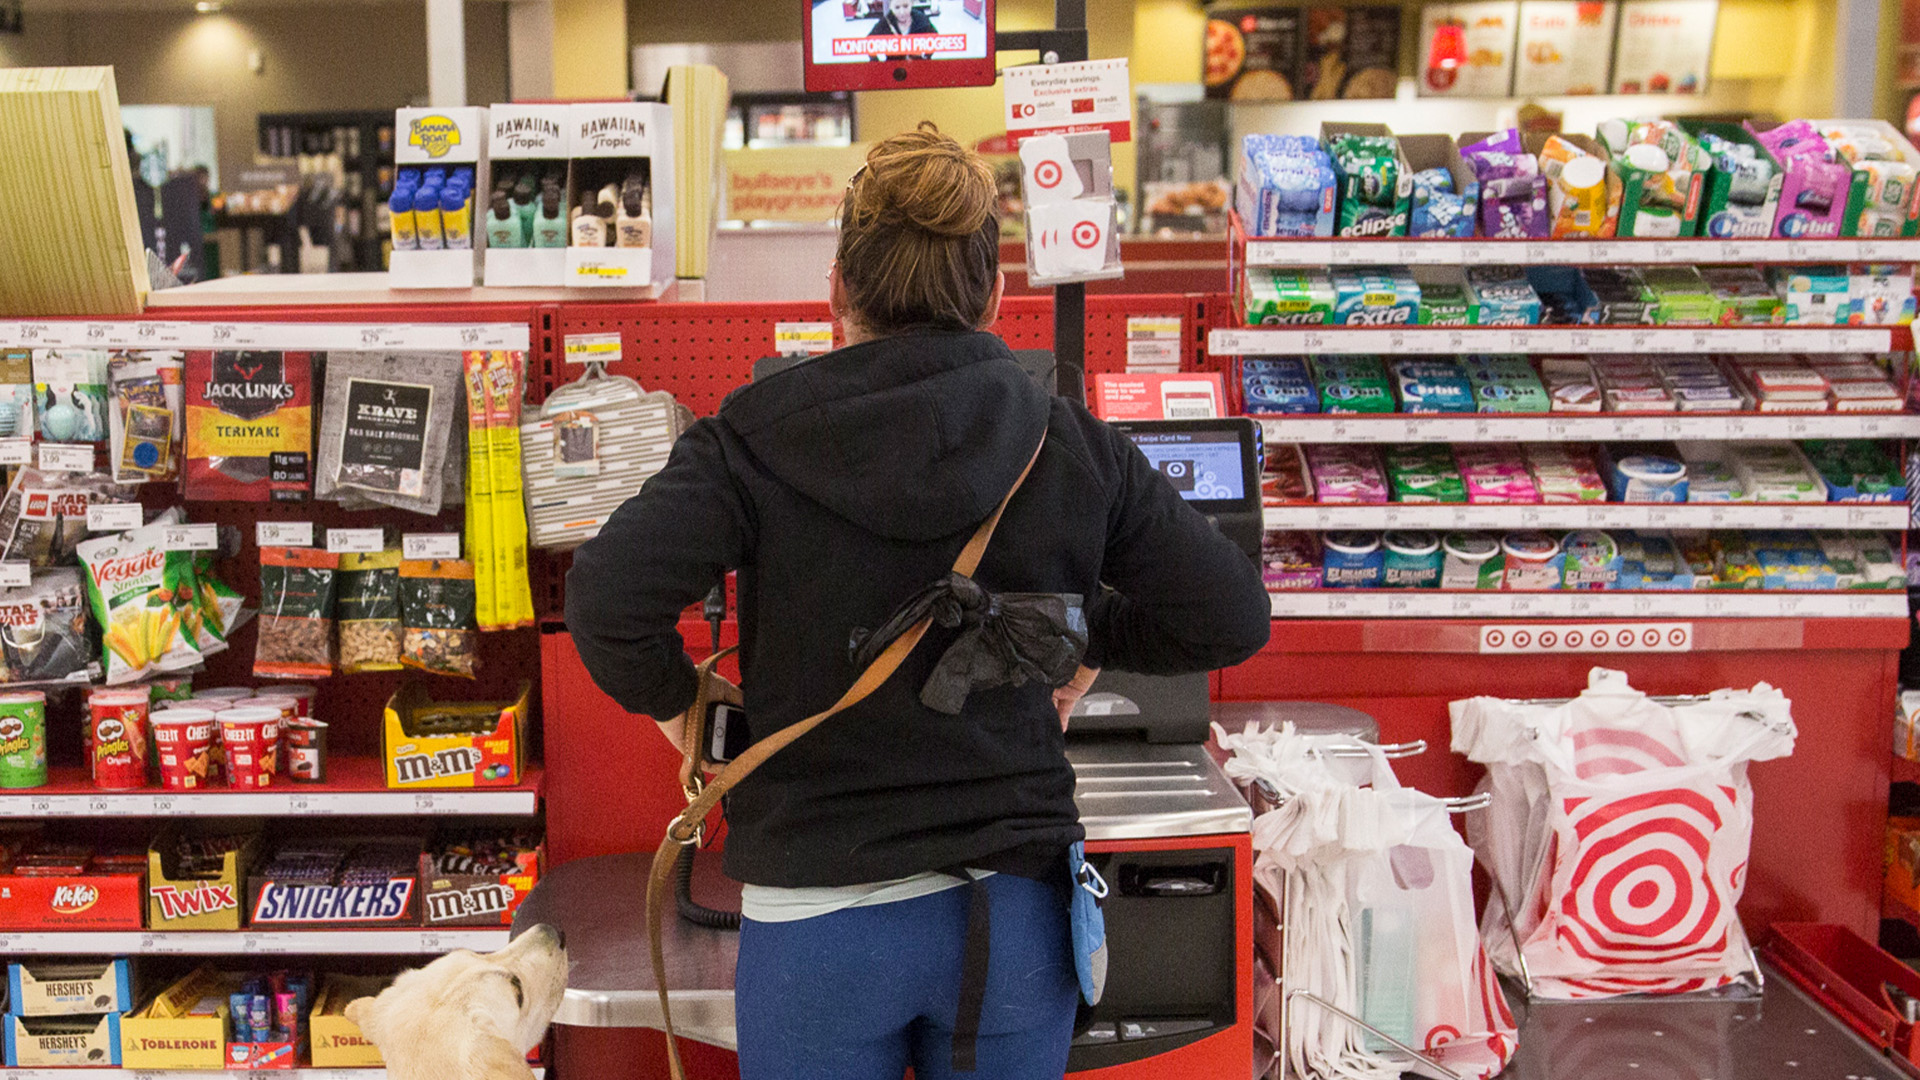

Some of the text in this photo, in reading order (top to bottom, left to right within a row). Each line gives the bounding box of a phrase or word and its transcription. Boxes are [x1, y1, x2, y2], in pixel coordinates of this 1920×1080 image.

[834, 36, 964, 54] MONITORING IN PROGRESS
[1031, 77, 1067, 87] Everyday
[1033, 87, 1071, 97] Exclusive
[496, 117, 559, 138] HAWAIIAN
[581, 116, 646, 138] HAWAIIAN
[421, 133, 449, 144] BOAT
[506, 135, 545, 149] Tropic
[592, 135, 631, 149] Tropic
[1341, 213, 1406, 237] eclipse
[202, 382, 244, 399] JACK
[1403, 383, 1461, 397] Orbit
[357, 404, 418, 420] KRAVE
[216, 426, 280, 438] TERIYAKI
[365, 429, 383, 439] SALT
[384, 431, 420, 441] ORIGINAL
[1139, 435, 1158, 443] Swipe
[273, 470, 287, 480] 80
[29, 500, 47, 510] LEGO
[52, 494, 87, 506] STAR
[51, 505, 88, 517] WARS
[91, 551, 165, 588] Veggie
[97, 739, 129, 761] Pringles
[31, 802, 50, 811] 1.00
[89, 802, 108, 811] 1.00
[153, 801, 172, 810] 1.00
[259, 881, 407, 919] SNICKERS
[45, 981, 94, 997] HERSHEY'S
[39, 1036, 88, 1050] HERSHEY'S
[141, 1037, 218, 1050] TOBLERONE
